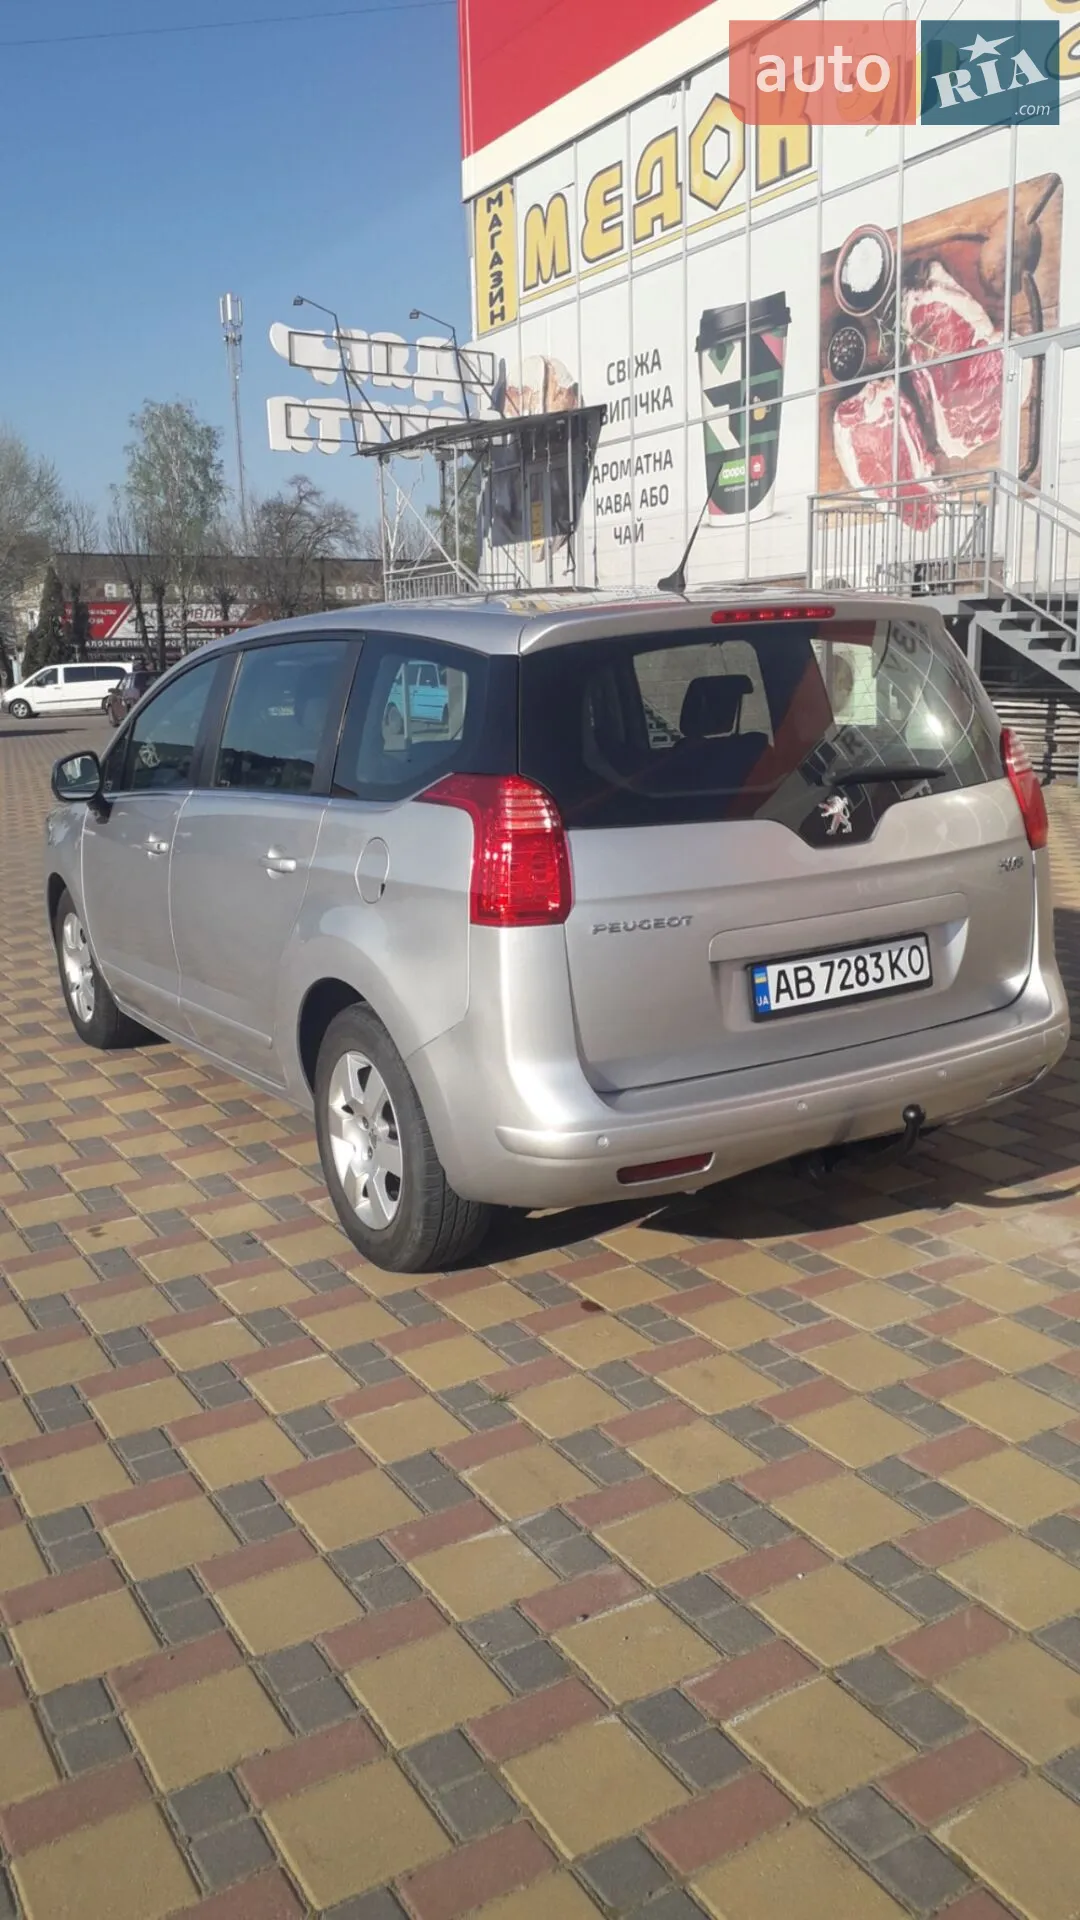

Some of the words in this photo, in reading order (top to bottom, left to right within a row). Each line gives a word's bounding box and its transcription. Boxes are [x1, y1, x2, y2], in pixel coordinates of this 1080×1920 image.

[486, 190, 506, 326] МАГАЗИН
[606, 348, 662, 386] СВІЖА
[600, 385, 674, 427] ВИПІЧКА
[592, 449, 674, 486] АРОМАТНА
[596, 491, 632, 516] КАВА
[640, 484, 669, 509] АБО
[613, 517, 644, 545] ЧАЙ
[592, 915, 695, 935] PEUGEOT
[774, 965, 816, 1004] AB
[820, 952, 885, 991] 7283
[756, 995, 770, 1008] UA
